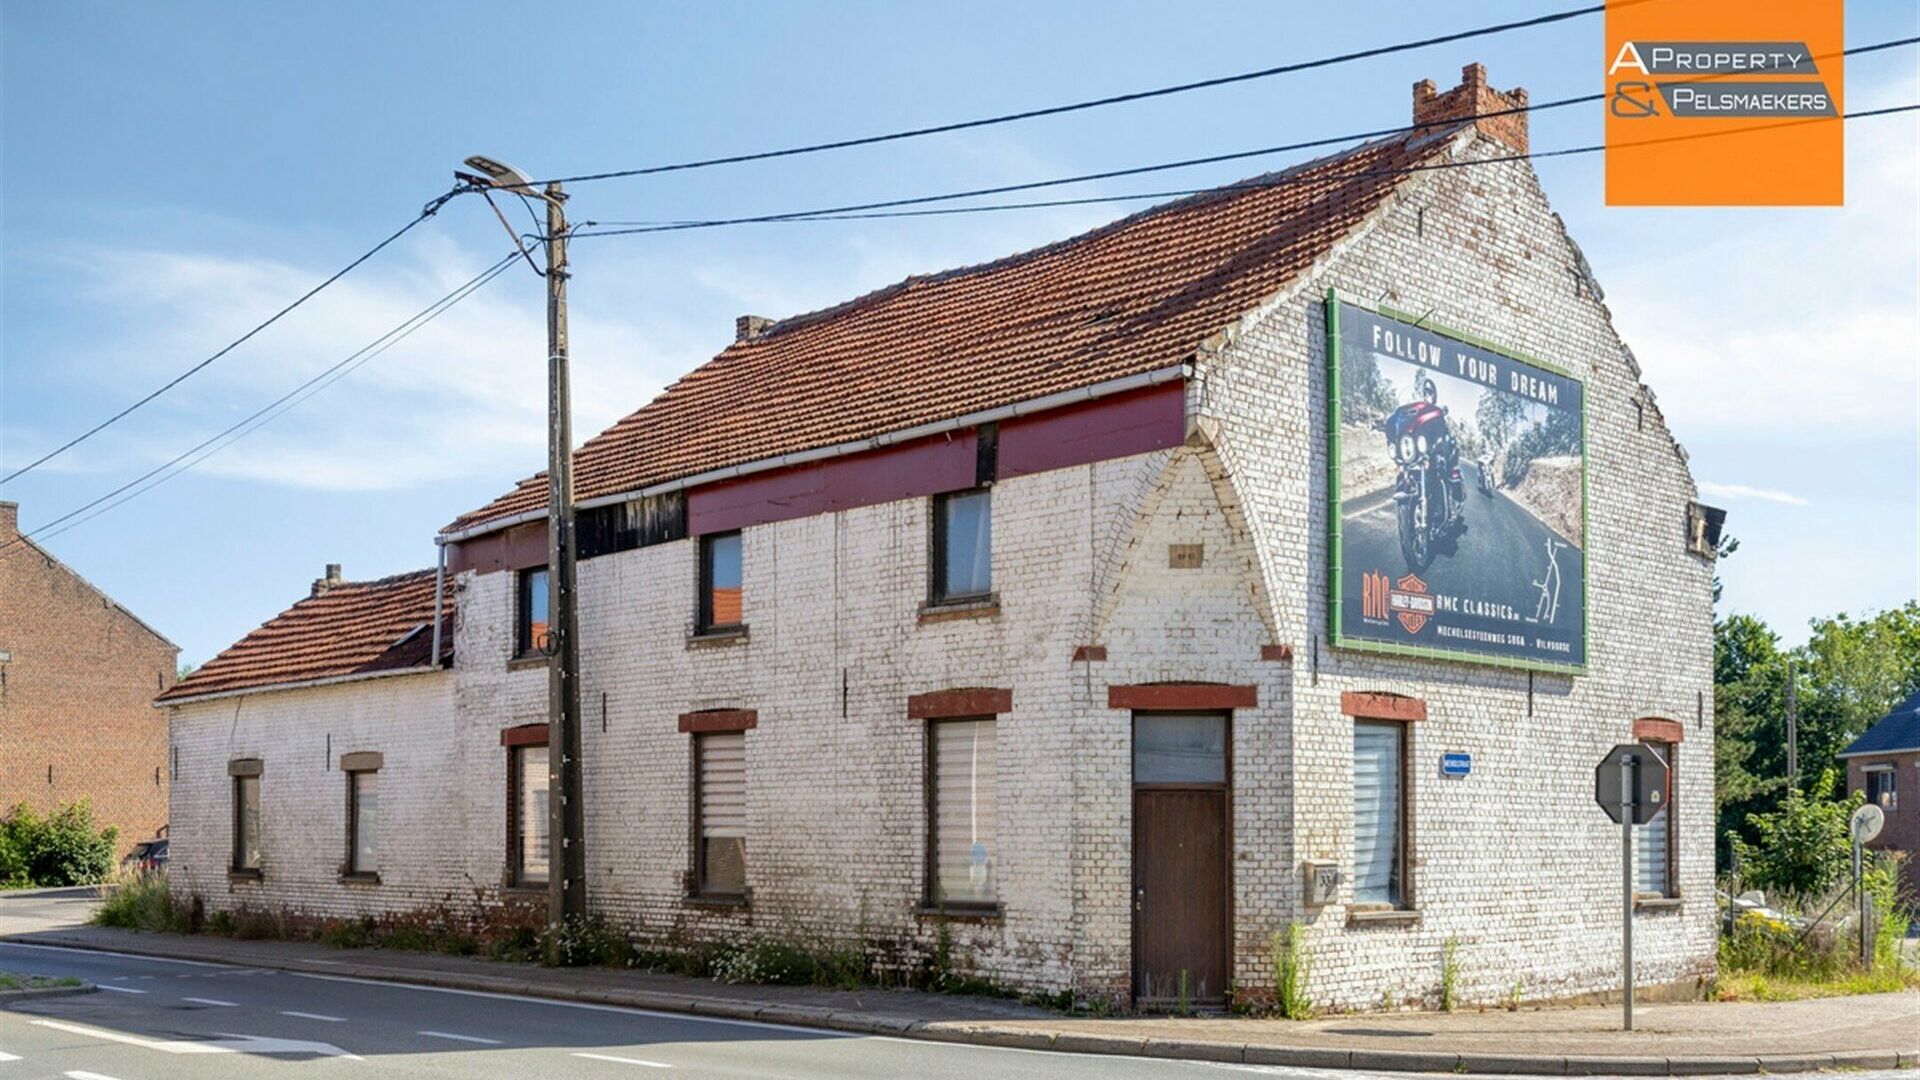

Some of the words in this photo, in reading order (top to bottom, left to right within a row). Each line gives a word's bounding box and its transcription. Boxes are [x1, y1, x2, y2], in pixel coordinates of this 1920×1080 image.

[1373, 325, 1441, 368] FOLLOW
[1457, 353, 1498, 386] YOUR
[1511, 371, 1559, 405] DREAM
[1363, 571, 1390, 620] RMC
[1436, 594, 1458, 611] RMC
